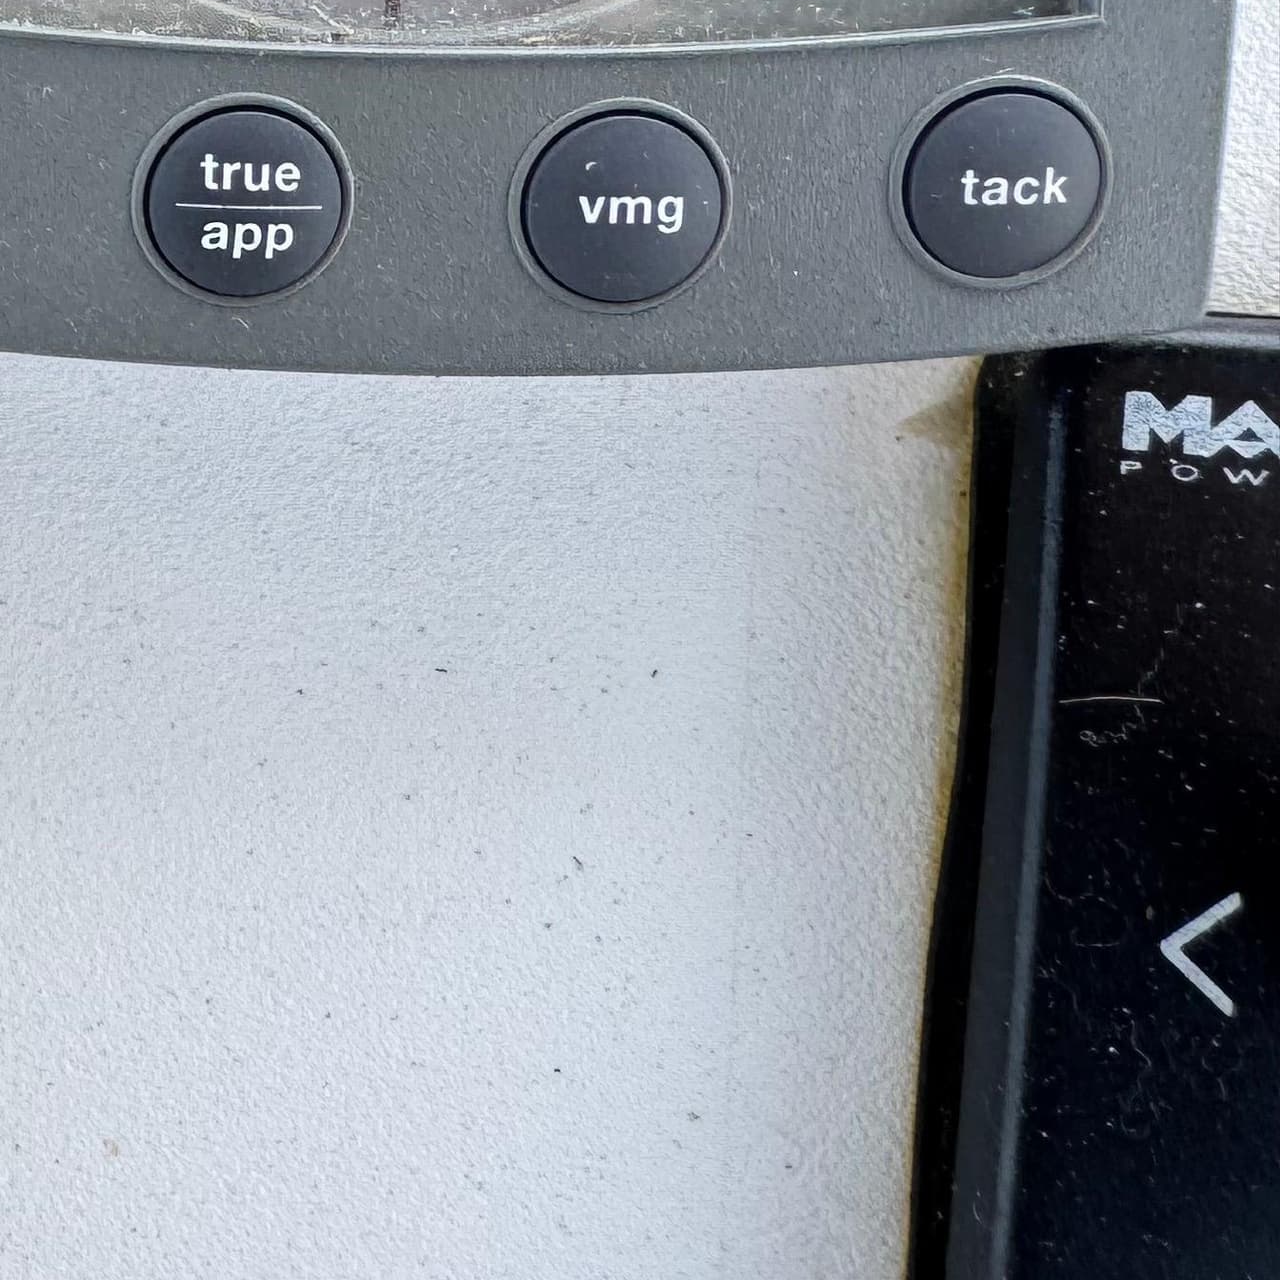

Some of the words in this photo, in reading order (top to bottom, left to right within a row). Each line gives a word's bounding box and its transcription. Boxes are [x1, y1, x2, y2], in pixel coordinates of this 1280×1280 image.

[200, 153, 301, 192] true
[960, 167, 1068, 206] tack
[578, 195, 684, 234] vmg
[200, 222, 294, 260] app
